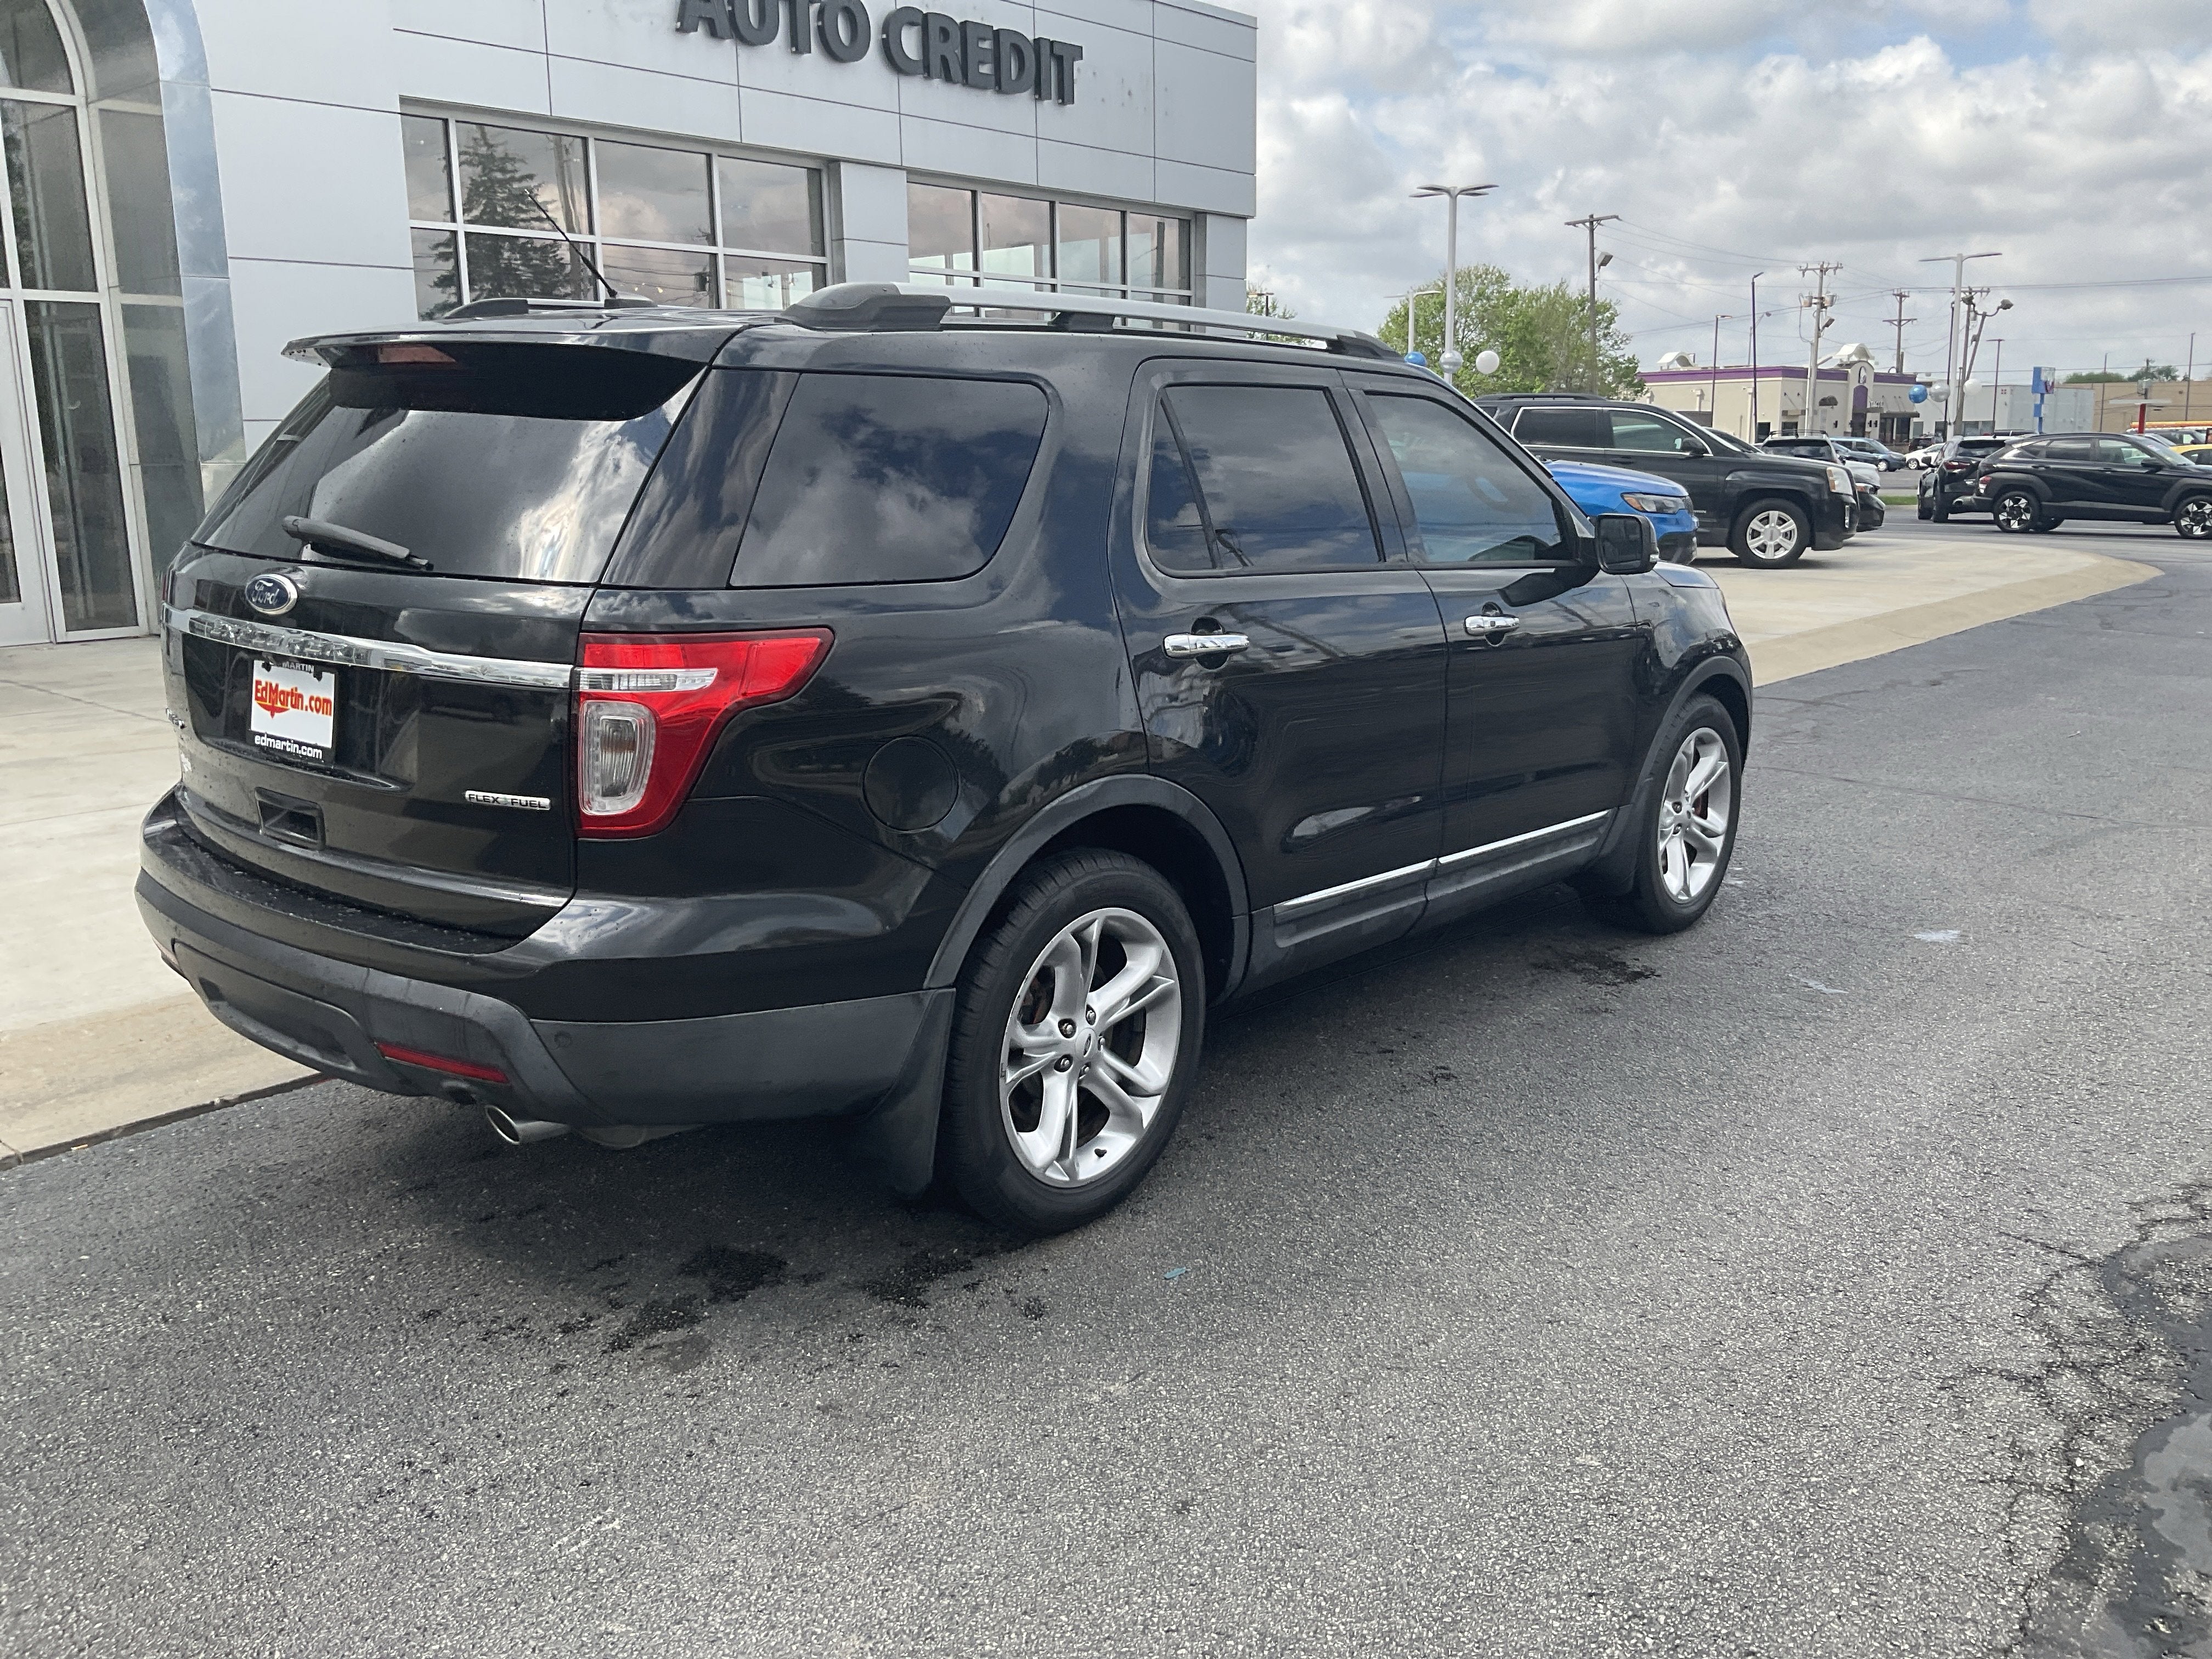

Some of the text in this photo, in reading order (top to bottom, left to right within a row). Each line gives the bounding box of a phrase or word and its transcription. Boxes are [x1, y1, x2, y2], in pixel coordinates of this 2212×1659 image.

[882, 6, 1083, 105] CREDIT
[252, 579, 280, 605] Ford
[282, 661, 314, 673] MARTIN
[255, 734, 323, 759] edmartin.com
[469, 794, 546, 809] FLEX FUEL
